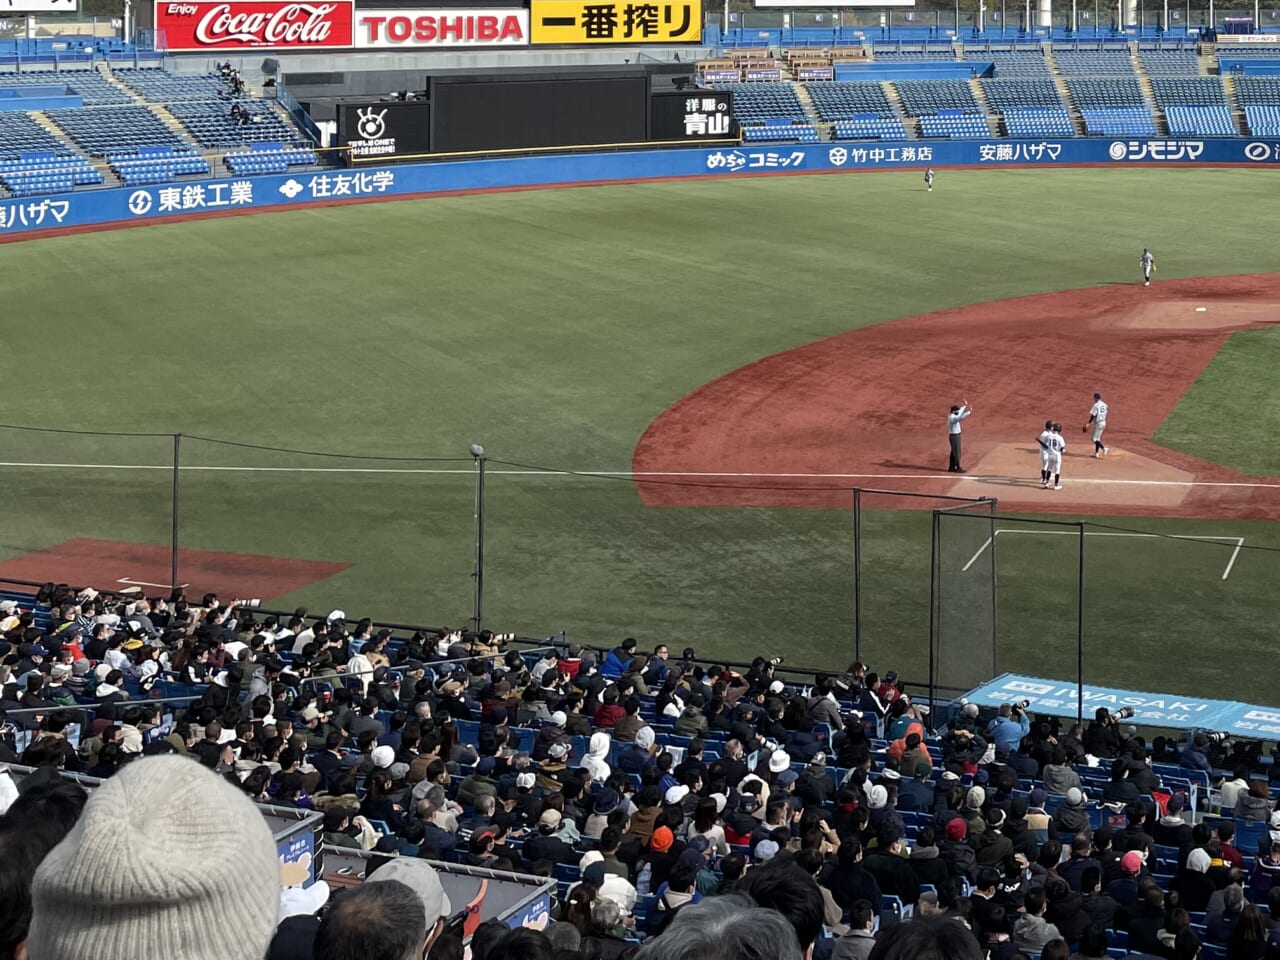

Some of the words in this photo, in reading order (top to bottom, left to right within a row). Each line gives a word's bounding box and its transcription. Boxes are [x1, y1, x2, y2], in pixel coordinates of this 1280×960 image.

[167, 3, 198, 15] Enjoy
[196, 3, 338, 44] Coca-Cola
[362, 16, 523, 42] TOSHIBA
[541, 4, 691, 39] 一番搾り
[686, 98, 727, 111] 洋服の
[684, 113, 729, 135] 青山
[706, 151, 805, 170] めちゃコミック
[851, 147, 933, 163] 竹中工務店
[979, 144, 1062, 161] 安藤ハザマ
[1128, 141, 1204, 160] シモジマ
[308, 171, 394, 198] 住友化学
[158, 181, 253, 212] 東鉄工業
[1053, 688, 1209, 712] IWASAKI
